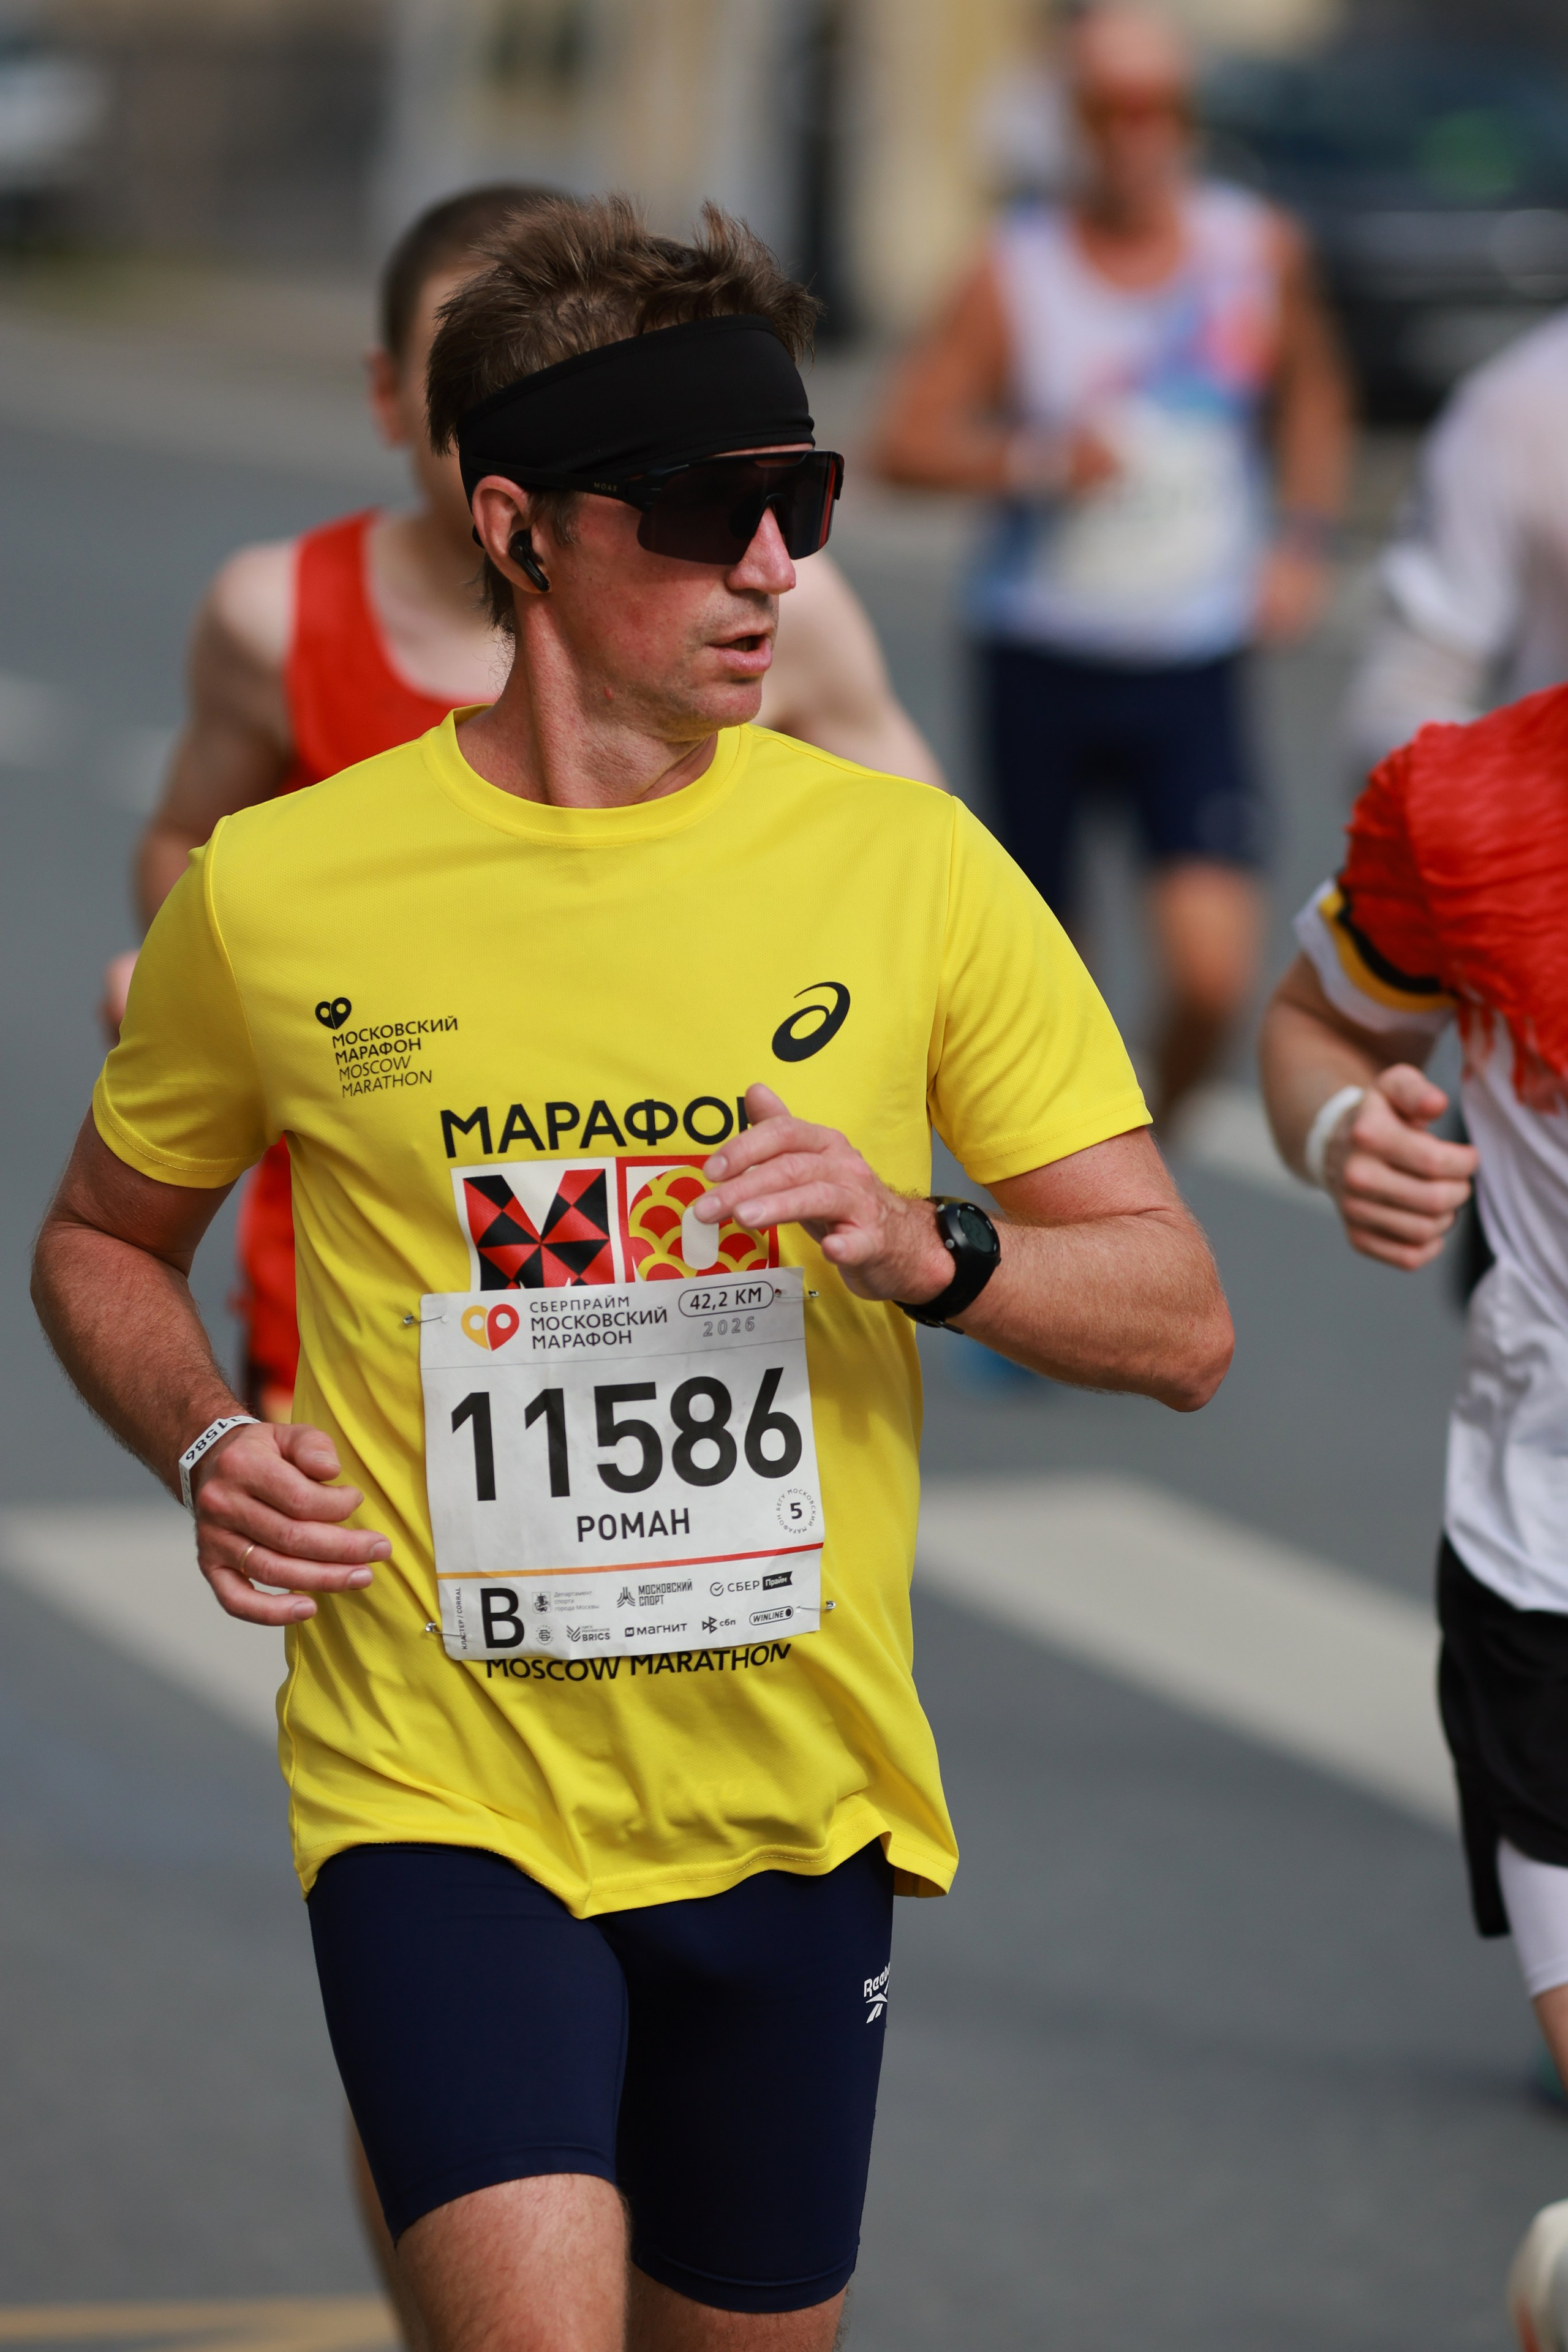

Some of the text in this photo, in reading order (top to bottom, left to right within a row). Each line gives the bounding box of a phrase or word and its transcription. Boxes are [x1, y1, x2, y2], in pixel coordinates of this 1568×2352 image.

[332, 1016, 458, 1049] МОСКОВСКИЙ
[335, 1038, 421, 1065] МАРАФОН
[339, 1055, 411, 1081] MOSCOW
[342, 1070, 432, 1098] MARATHON
[530, 1295, 630, 1313] СБЕРПРАЙМ
[690, 1287, 761, 1310] 42,2 КМ
[531, 1306, 668, 1331] МОСКОВСКИЙ
[703, 1316, 755, 1337] 2026
[532, 1330, 632, 1349] МАРАФОН
[450, 1366, 802, 1502] 11586
[790, 1502, 802, 1519] 5
[576, 1507, 690, 1542] РОМАН
[638, 1578, 693, 1596] МОСКОВСКИЙ
[728, 1576, 788, 1593] СБЕР Прайм
[639, 1594, 665, 1607] СПОРТ
[719, 1618, 736, 1627] сбп
[753, 1610, 784, 1623] WINLINE
[458, 1620, 467, 1649] КЛАСТЕР
[582, 1632, 610, 1642] BRICS
[636, 1623, 687, 1635] магнит
[486, 1643, 791, 1681] MOSCOW MARATHON
[864, 1962, 890, 1997] Reeb
